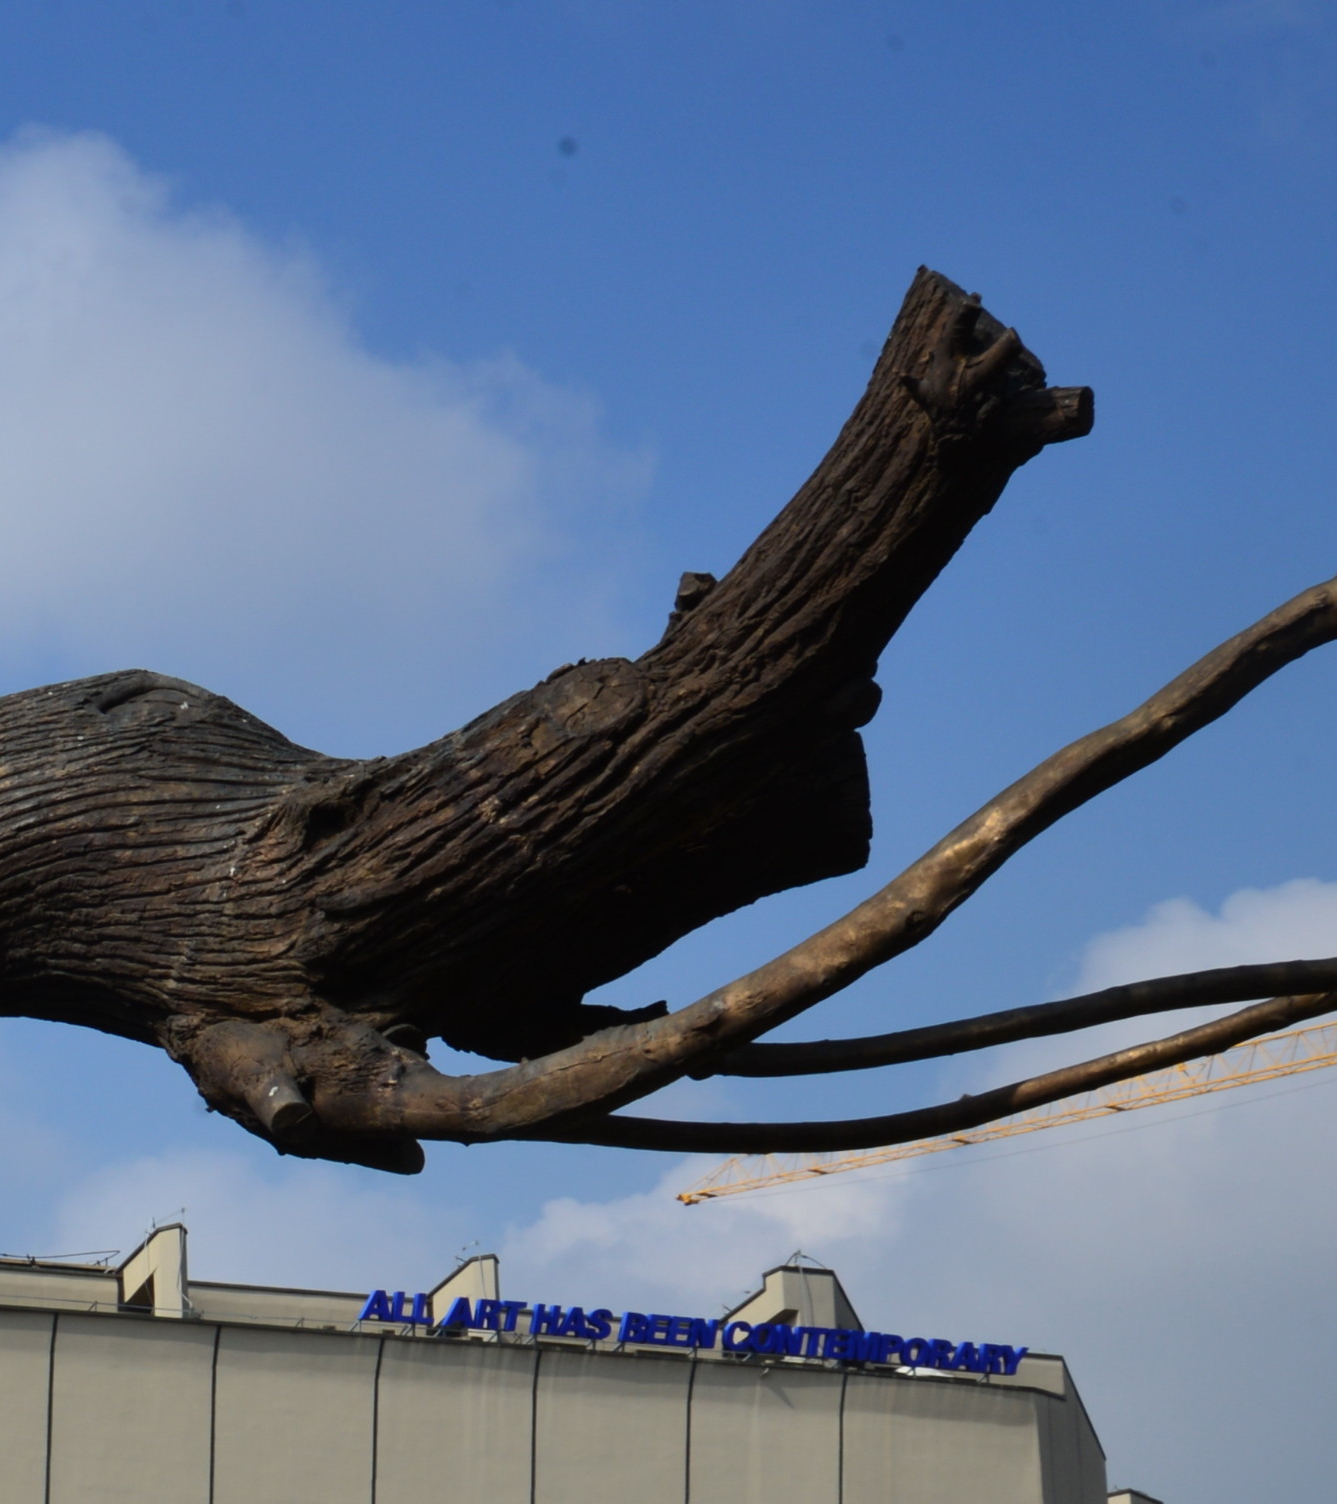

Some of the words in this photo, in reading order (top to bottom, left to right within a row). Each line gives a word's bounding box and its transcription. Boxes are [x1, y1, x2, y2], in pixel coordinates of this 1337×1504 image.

[359, 1290, 434, 1325] ALL
[442, 1297, 527, 1332] ART
[530, 1303, 613, 1341] HAS
[618, 1312, 721, 1349] BEEN
[723, 1320, 1029, 1375] CONTEMPORARY
